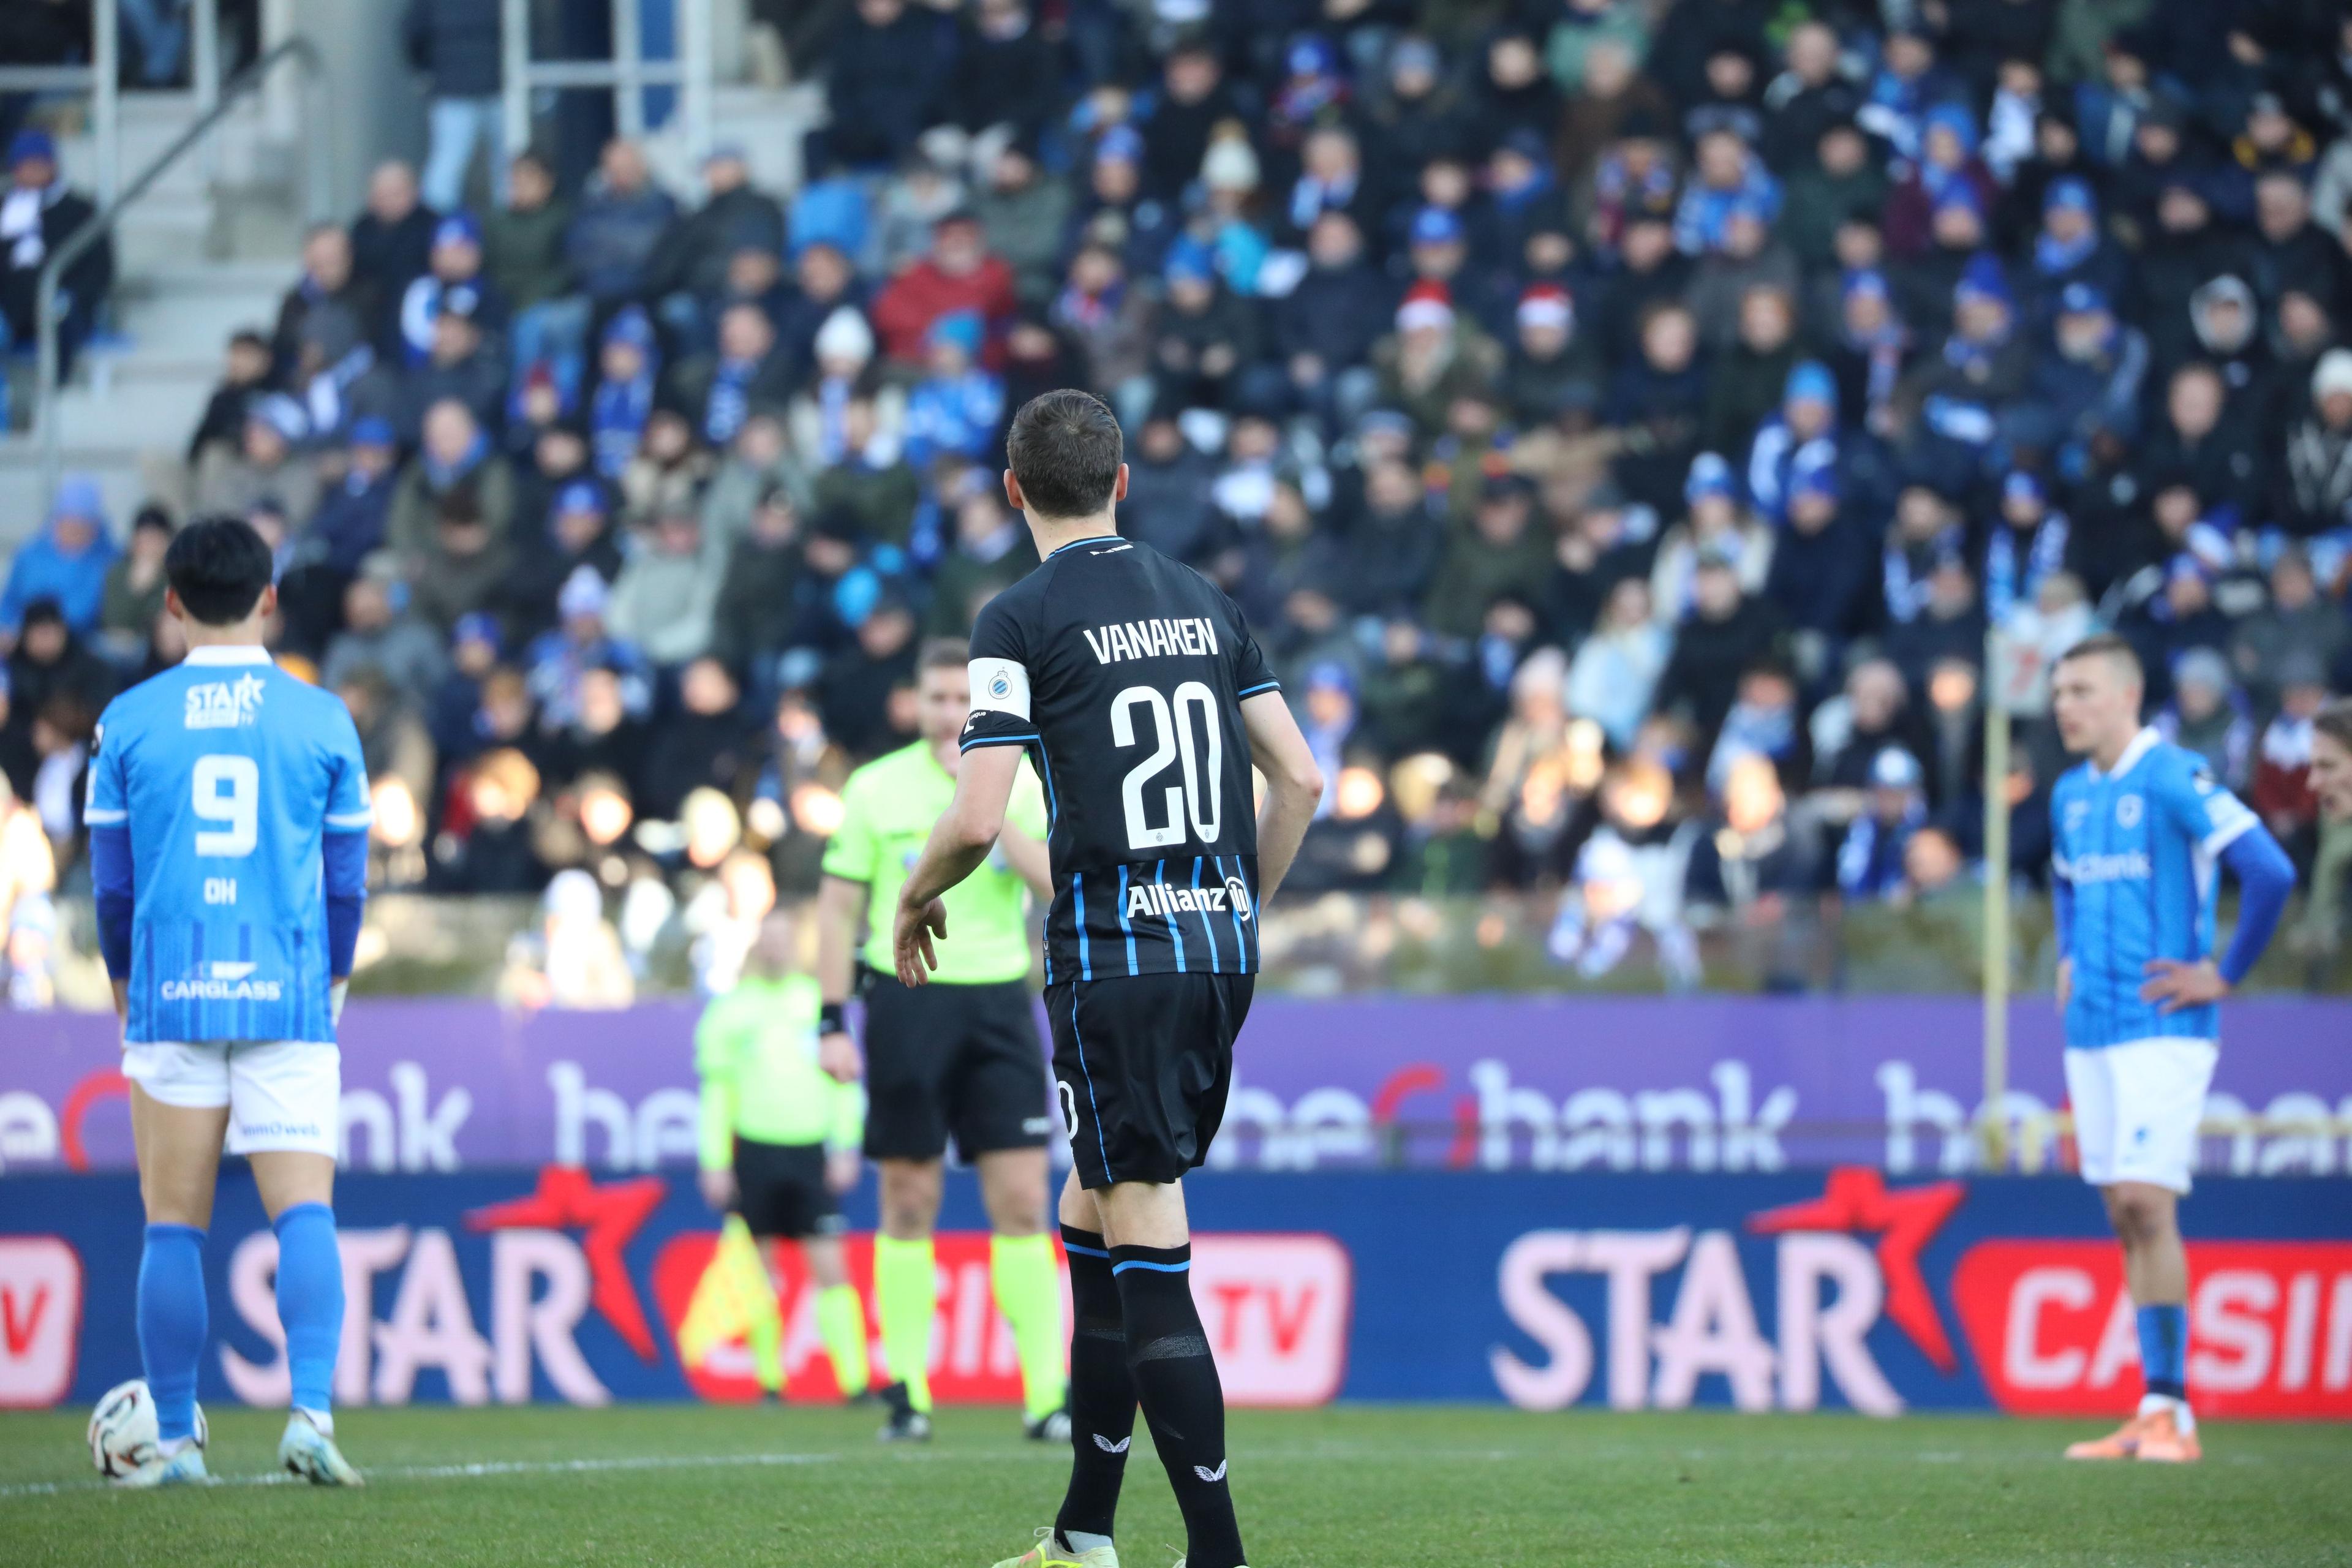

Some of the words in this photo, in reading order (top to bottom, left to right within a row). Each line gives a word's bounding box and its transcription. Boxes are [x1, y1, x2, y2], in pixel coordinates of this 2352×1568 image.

[1083, 618, 1218, 665] VANAKEN
[1110, 681, 1222, 850] 20
[192, 754, 259, 857] 9
[204, 877, 237, 905] OH
[1126, 883, 1226, 919] Allianz
[161, 980, 282, 1001] CARGLASS
[219, 1224, 612, 1408] STAR
[1210, 1283, 1317, 1355] TV
[1490, 1224, 1906, 1415] STAR
